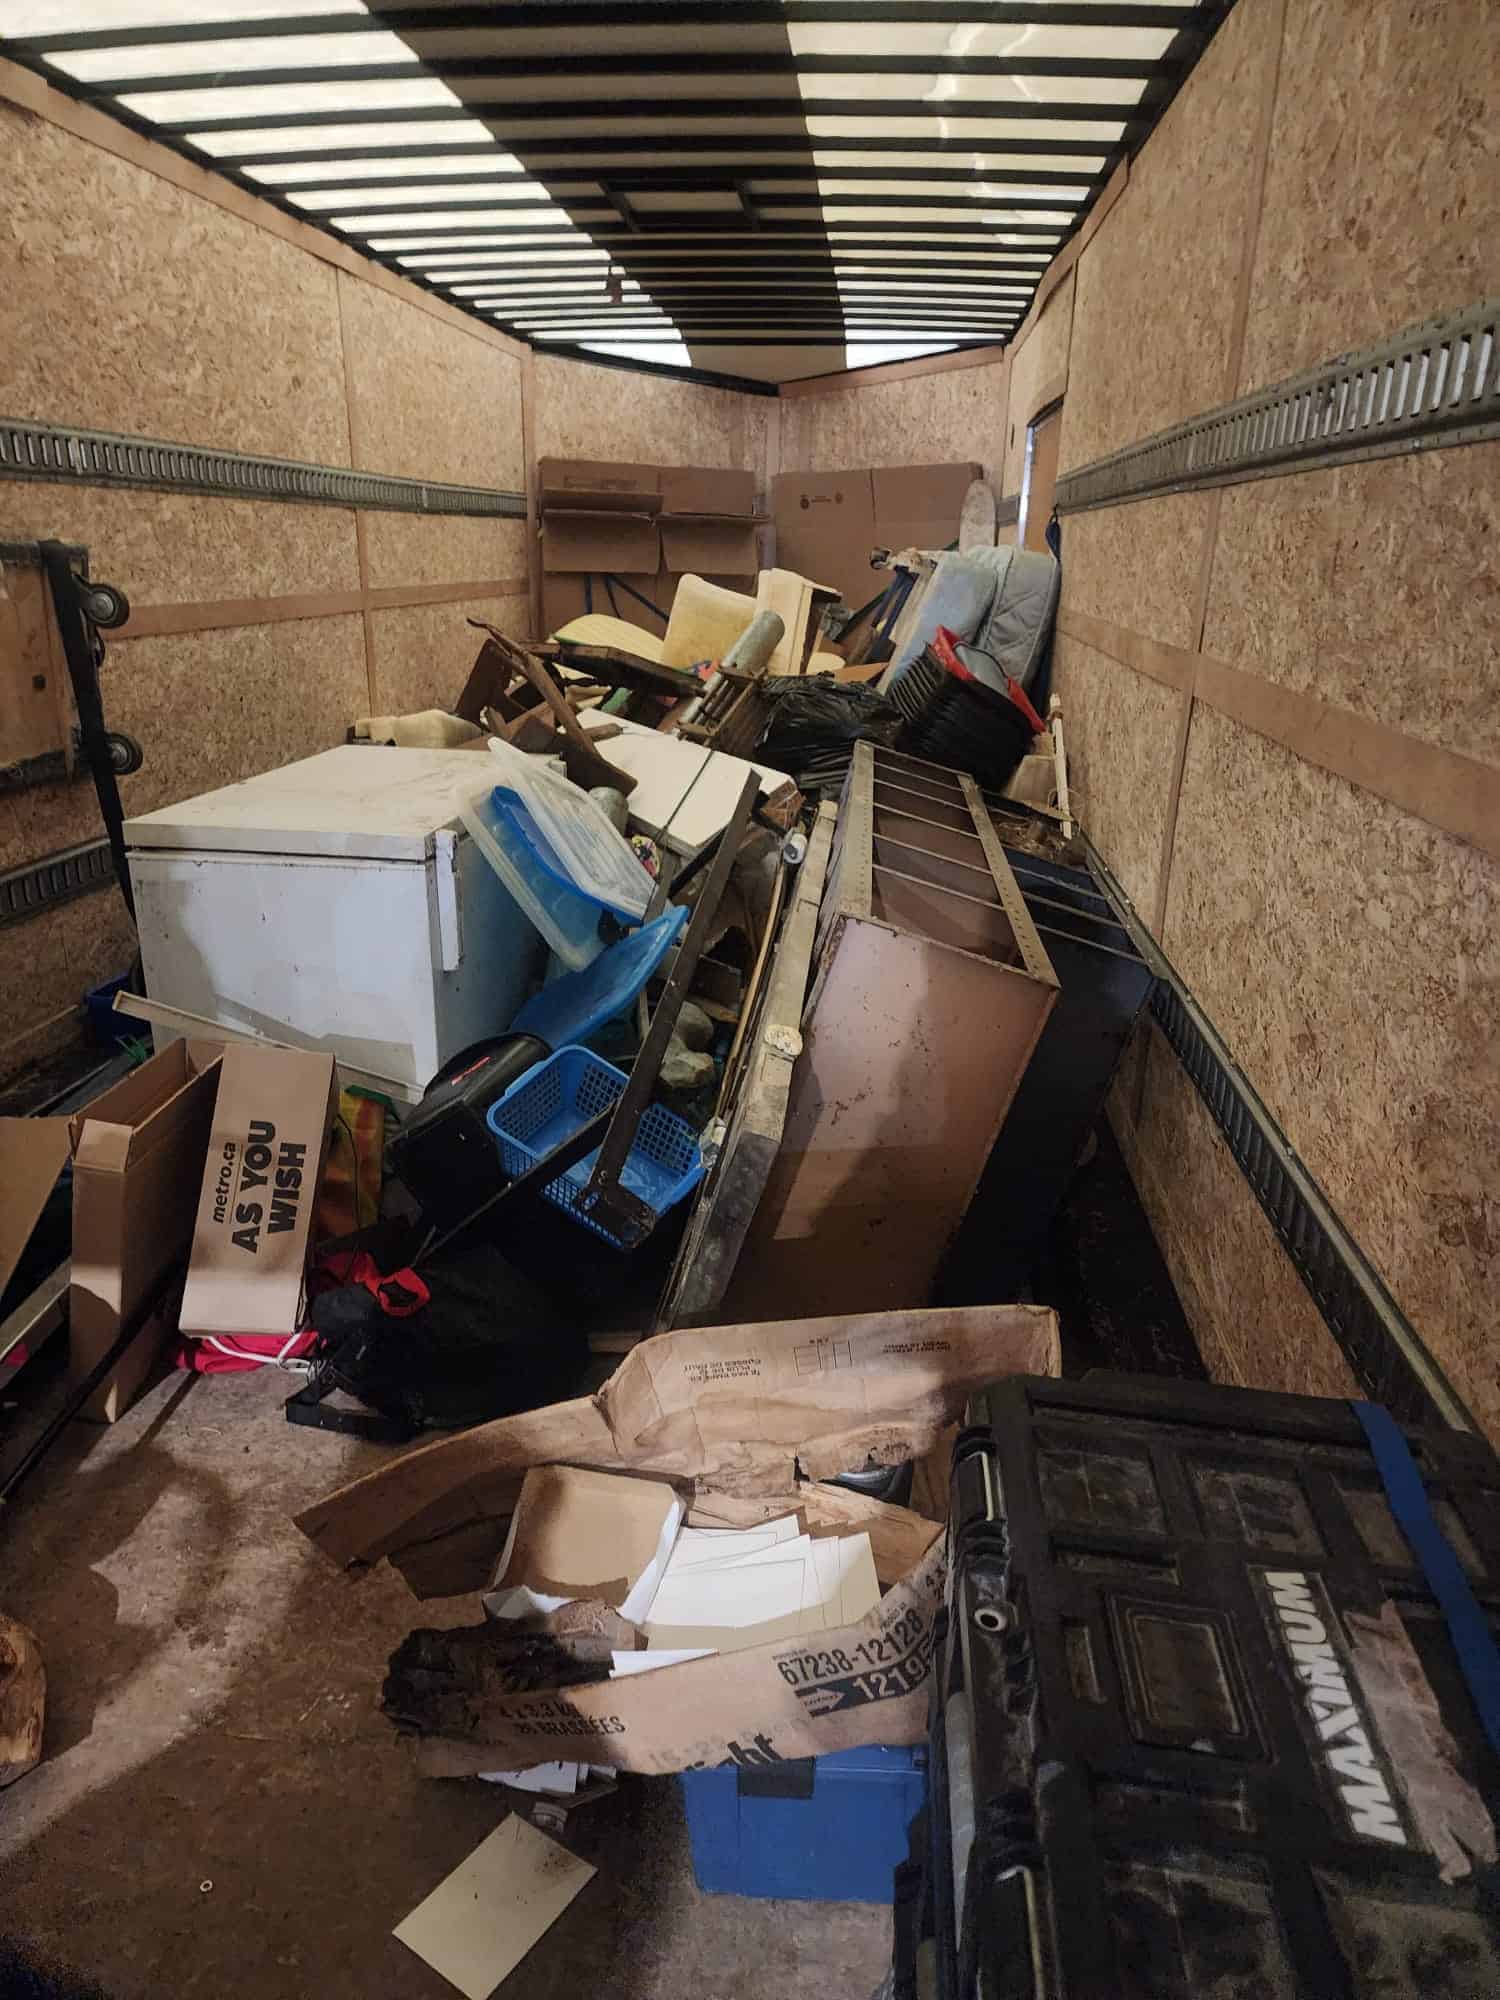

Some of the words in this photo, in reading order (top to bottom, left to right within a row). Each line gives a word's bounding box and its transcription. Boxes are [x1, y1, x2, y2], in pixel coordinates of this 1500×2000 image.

[213, 1142, 236, 1224] metro.ca
[240, 1120, 276, 1192] YOU
[267, 1142, 307, 1234] WISH
[231, 1203, 264, 1254] AS
[777, 1608, 924, 1686] 67238-12128
[1265, 1572, 1408, 1846] MAXIMUM
